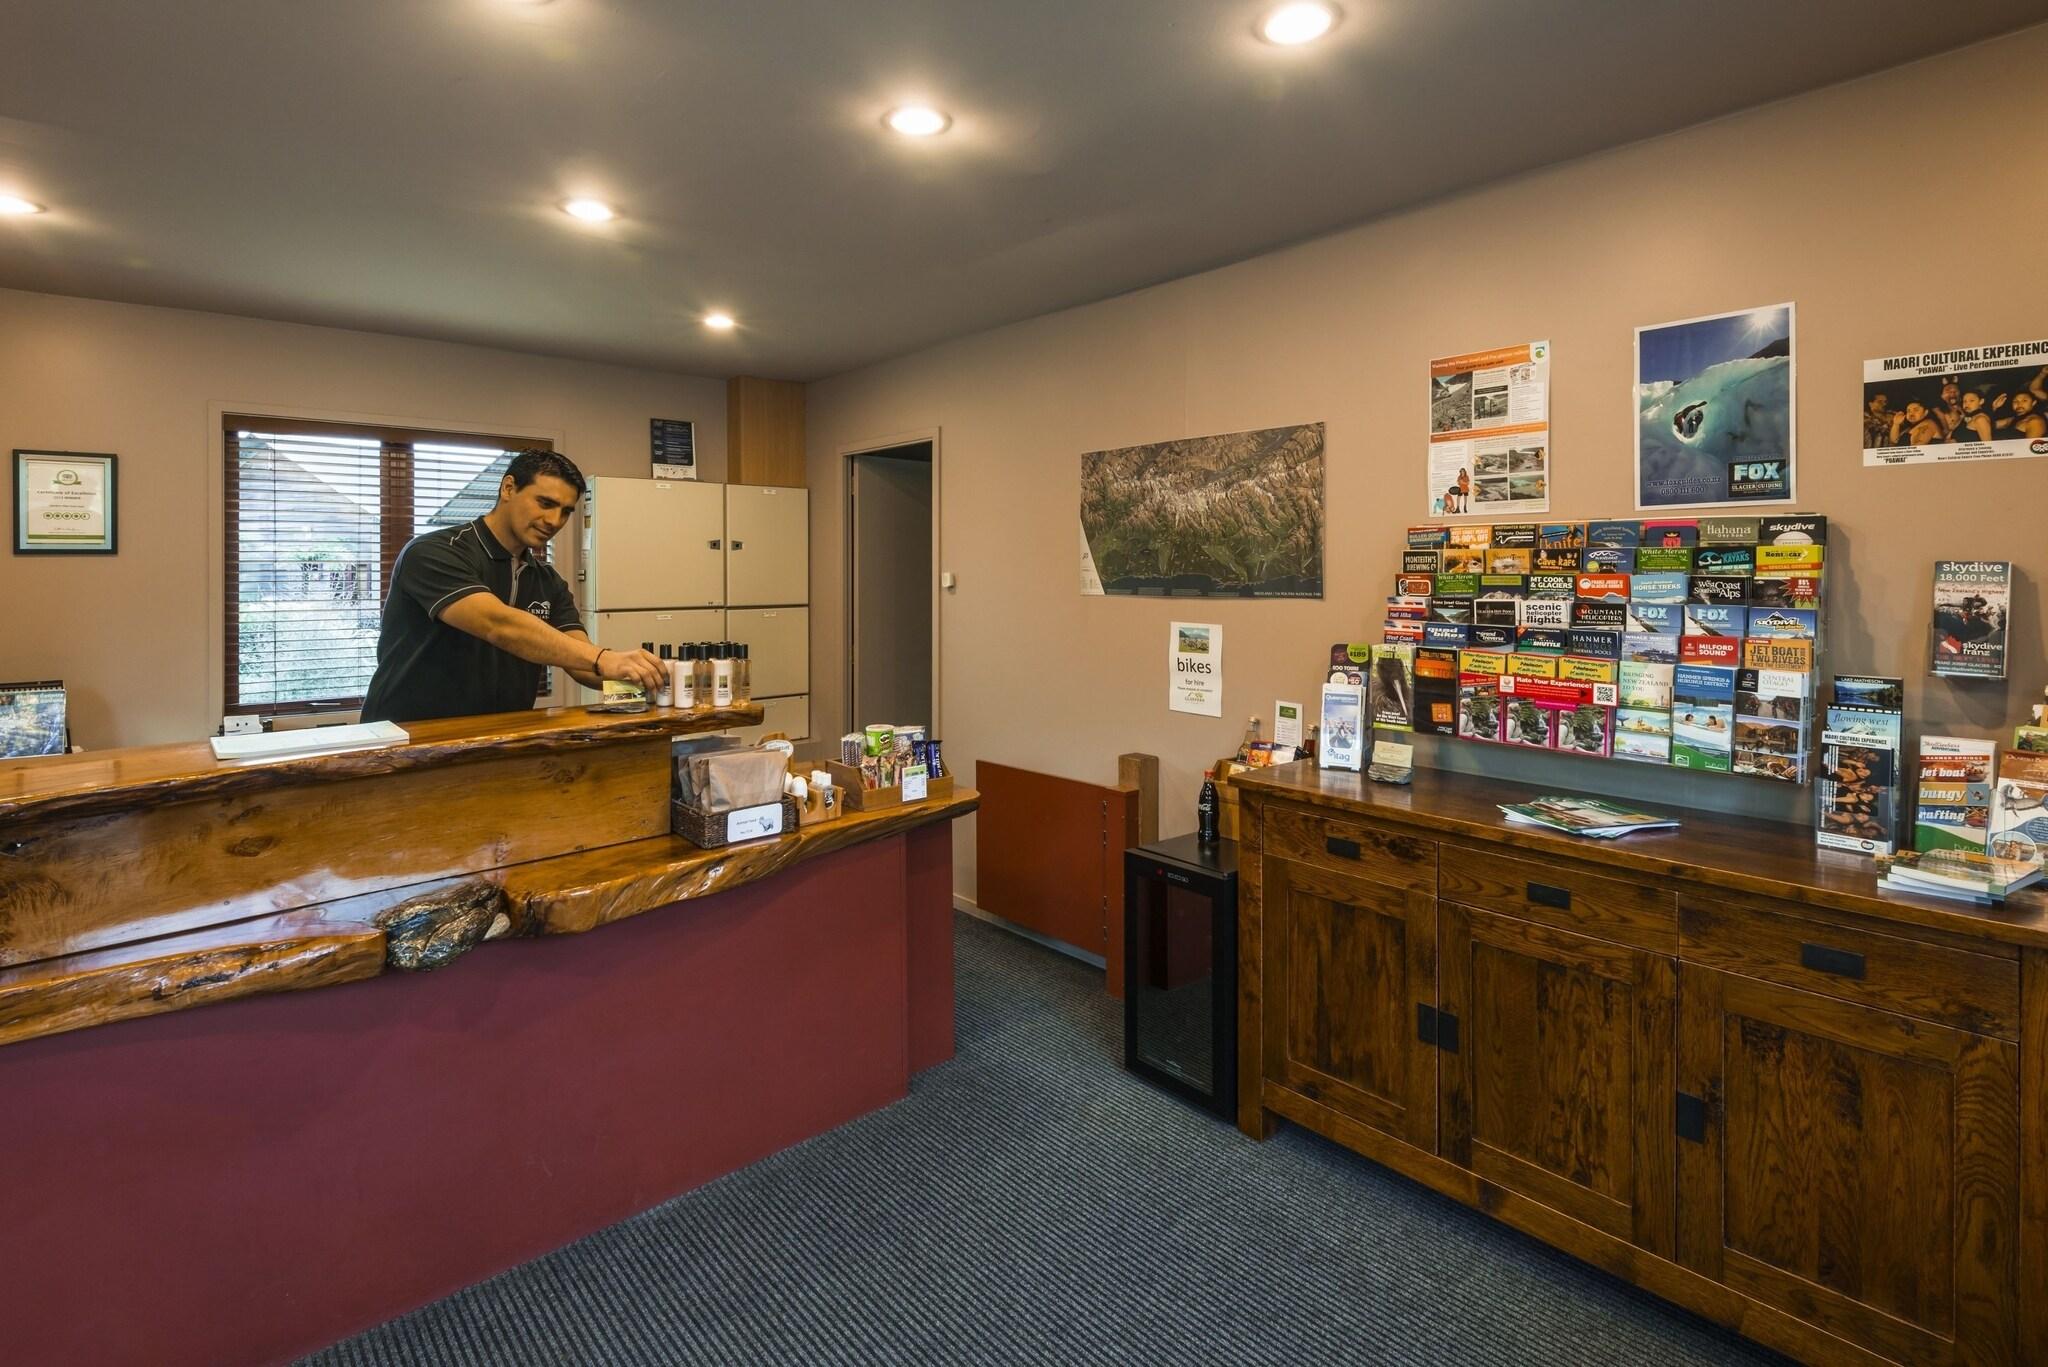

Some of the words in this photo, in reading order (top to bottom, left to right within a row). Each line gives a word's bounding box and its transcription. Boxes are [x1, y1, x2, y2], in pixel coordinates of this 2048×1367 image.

[1884, 357, 1920, 371] MAORI
[1922, 350, 1980, 367] CULTURAL
[1970, 358, 2019, 370] Performance
[1734, 462, 1780, 481] FOX
[1660, 487, 1678, 496] 0800
[1707, 524, 1751, 534] Hahana
[1769, 522, 1816, 533] skydive
[1544, 536, 1582, 549] knife
[1405, 556, 1437, 564] MONTEITH'S
[1406, 563, 1430, 571] BREWING
[1943, 561, 2002, 574] skydive
[1940, 574, 1977, 582] 18,000
[1980, 575, 2005, 583] Feet
[1698, 580, 1715, 588] West
[1714, 581, 1740, 590] Coast
[1719, 589, 1741, 599] Alps
[1638, 608, 1668, 619] FOX
[1697, 608, 1728, 620] FOX
[1526, 616, 1562, 625] flights
[1572, 635, 1612, 644] HANMER
[1962, 641, 2002, 650] skydive
[1750, 646, 1770, 656] JET
[1772, 647, 1800, 656] BOAT
[1750, 655, 1770, 663] TWO
[1772, 656, 1806, 665] RIVERS
[1177, 657, 1212, 674] bikes
[1550, 680, 1592, 689] Experience!
[1920, 768, 1937, 778] jet
[1938, 768, 1966, 777] boat
[1920, 788, 1966, 802] bungy
[1919, 810, 1966, 822] rafting
